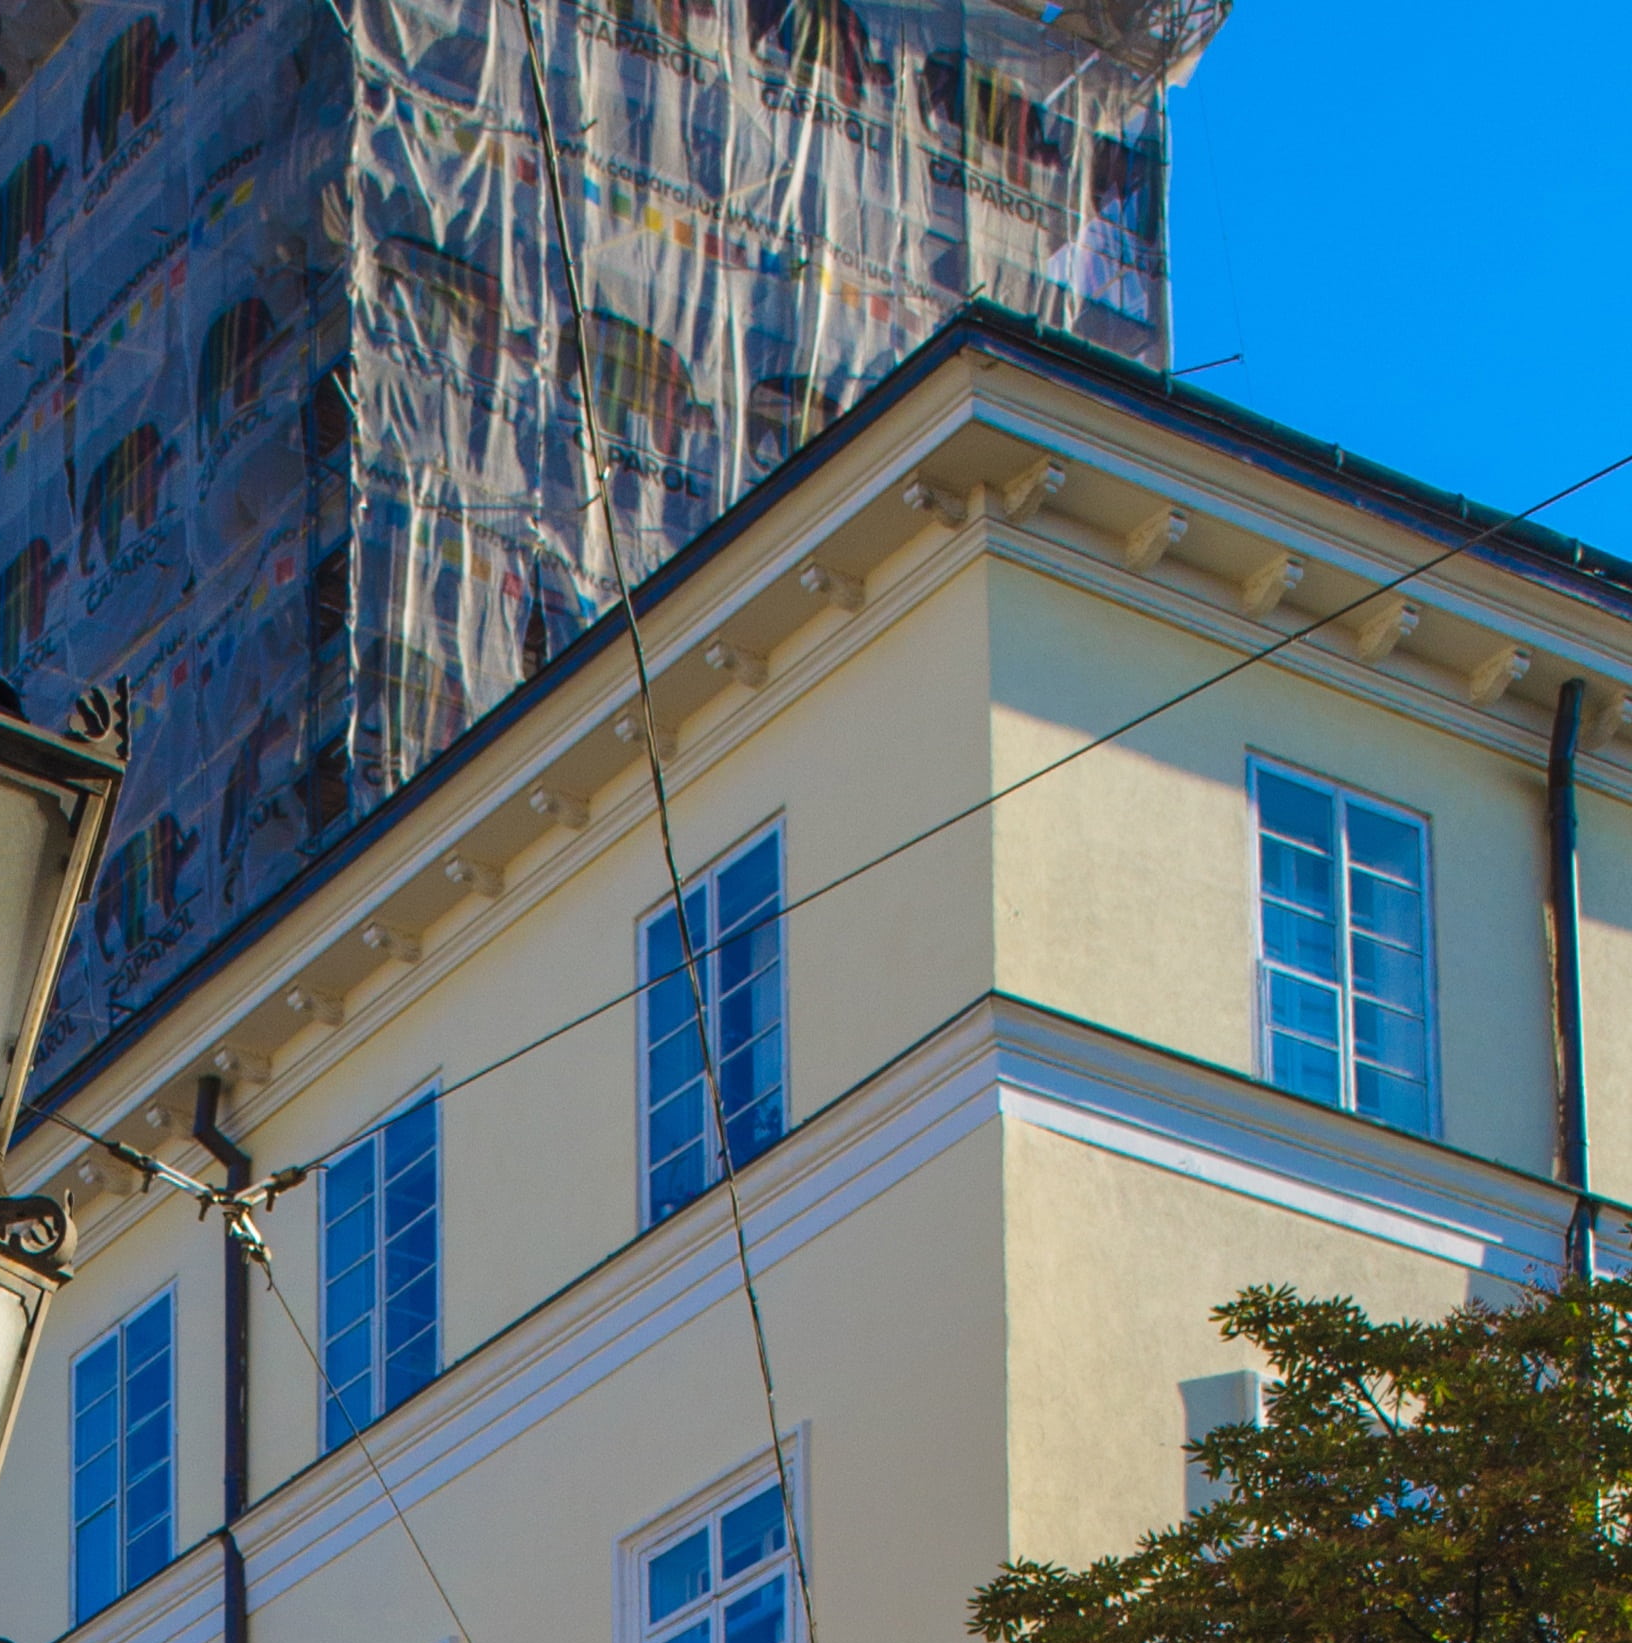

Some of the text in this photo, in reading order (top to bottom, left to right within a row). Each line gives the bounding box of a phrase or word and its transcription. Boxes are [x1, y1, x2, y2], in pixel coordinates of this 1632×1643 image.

[577, 13, 705, 84] CAPAROL
[762, 86, 880, 152] CAPAROL
[928, 157, 1050, 230] CAPAROL
[574, 429, 700, 497] CPAROL
[111, 908, 195, 996] CAPAROL
